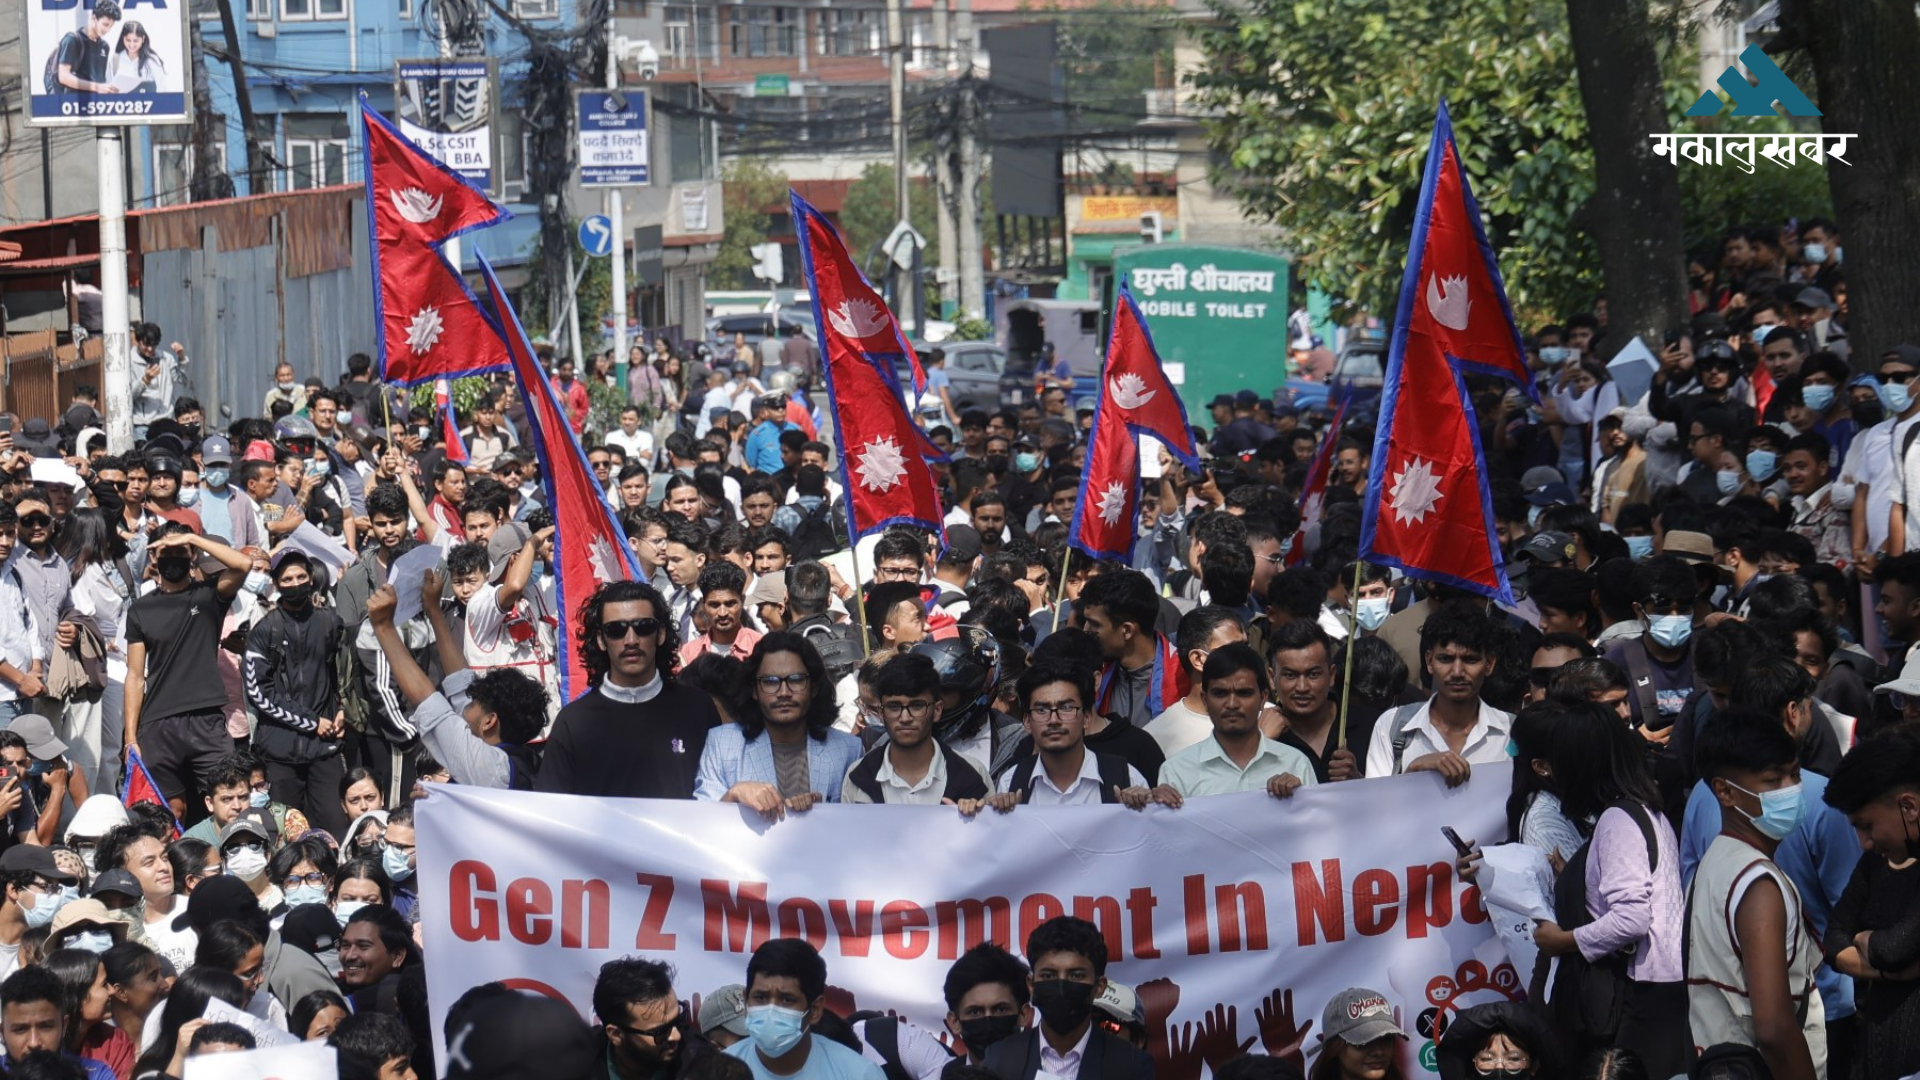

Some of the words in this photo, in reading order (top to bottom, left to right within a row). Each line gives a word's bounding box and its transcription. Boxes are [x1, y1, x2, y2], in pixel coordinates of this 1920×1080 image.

[61, 101, 153, 115] 01-5970287
[454, 152, 483, 165] BBA
[1132, 262, 1188, 296] घुम्ती
[1190, 263, 1275, 293] शौचालय
[1205, 302, 1267, 318] TOILET
[449, 859, 610, 950] Gen
[635, 872, 677, 951] Z
[1183, 873, 1269, 956] In
[1291, 858, 1491, 947] Nepa
